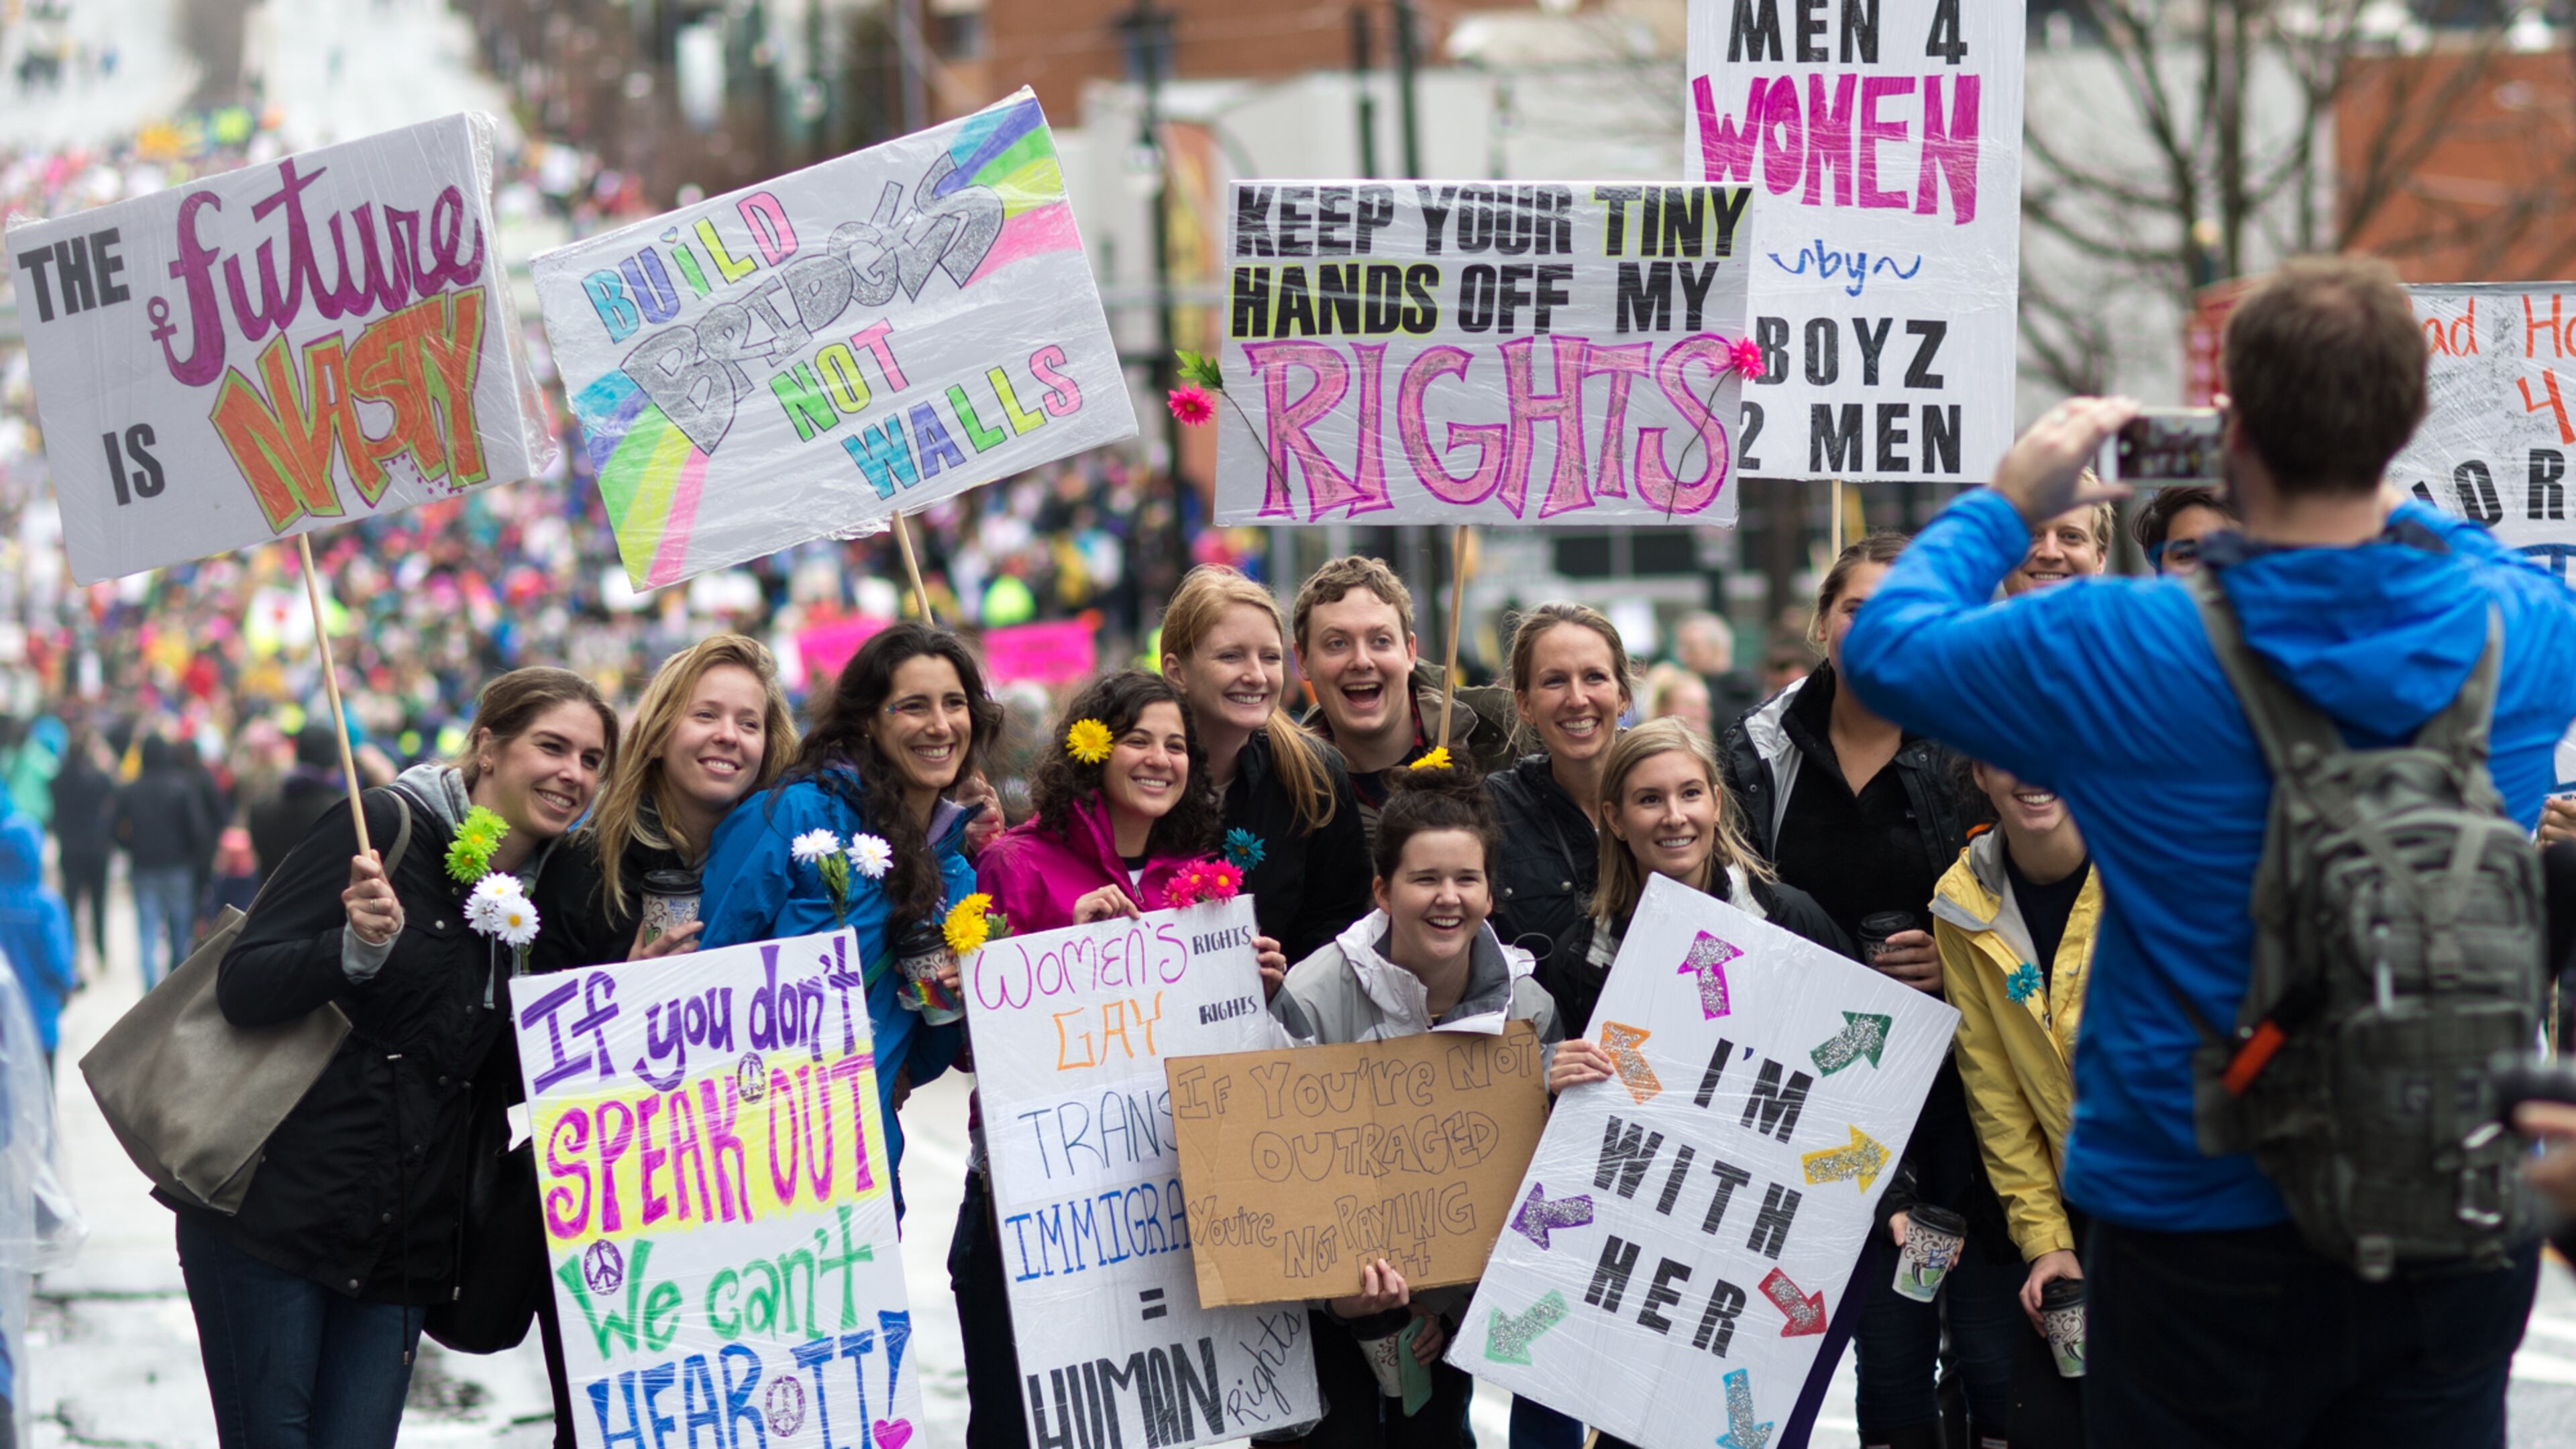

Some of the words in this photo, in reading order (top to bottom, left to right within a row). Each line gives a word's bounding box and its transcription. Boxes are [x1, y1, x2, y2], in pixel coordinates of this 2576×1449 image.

[1727, 0, 1879, 64] MEN
[1925, 0, 1968, 65] 4
[1692, 72, 1980, 225] WOMEN
[17, 227, 131, 323] THE
[148, 157, 485, 387] future
[1236, 184, 1395, 258] KEEP
[1417, 182, 1573, 256] YOUR
[1591, 185, 1754, 258] TINY
[619, 150, 1004, 458] BRIDGES
[1230, 260, 1440, 338] HANDS
[1457, 263, 1574, 335] OFF
[1615, 261, 1719, 333] MY
[1755, 317, 1947, 389] BOYZ
[2403, 296, 2479, 357] ad
[102, 423, 166, 506] IS
[209, 285, 490, 536] NASTY
[768, 317, 910, 442] NOT
[841, 343, 1083, 500] WALLS
[1241, 331, 1733, 522] RIGHTS
[1737, 401, 1764, 470] 2
[1809, 403, 1961, 474] MEN
[1192, 925, 1251, 955] RIGHTS
[521, 971, 619, 1095] If
[633, 987, 735, 1092] you
[749, 936, 861, 1062] don't
[1052, 990, 1164, 1071] GAY
[1199, 995, 1257, 1025] RIGHTS
[545, 1075, 753, 1240] SPEAK
[769, 1053, 875, 1207] OUT
[1251, 1110, 1499, 1183] OUTRAGED
[1693, 1037, 1815, 1144] I'M
[1334, 1181, 1477, 1251] PAYING
[1593, 1114, 1803, 1260] WITH
[555, 1238, 684, 1361] We
[704, 1205, 874, 1342] can't
[1583, 1234, 1748, 1359] HER
[1026, 1337, 1225, 1449] HUMAN
[1226, 1310, 1301, 1427] Rights
